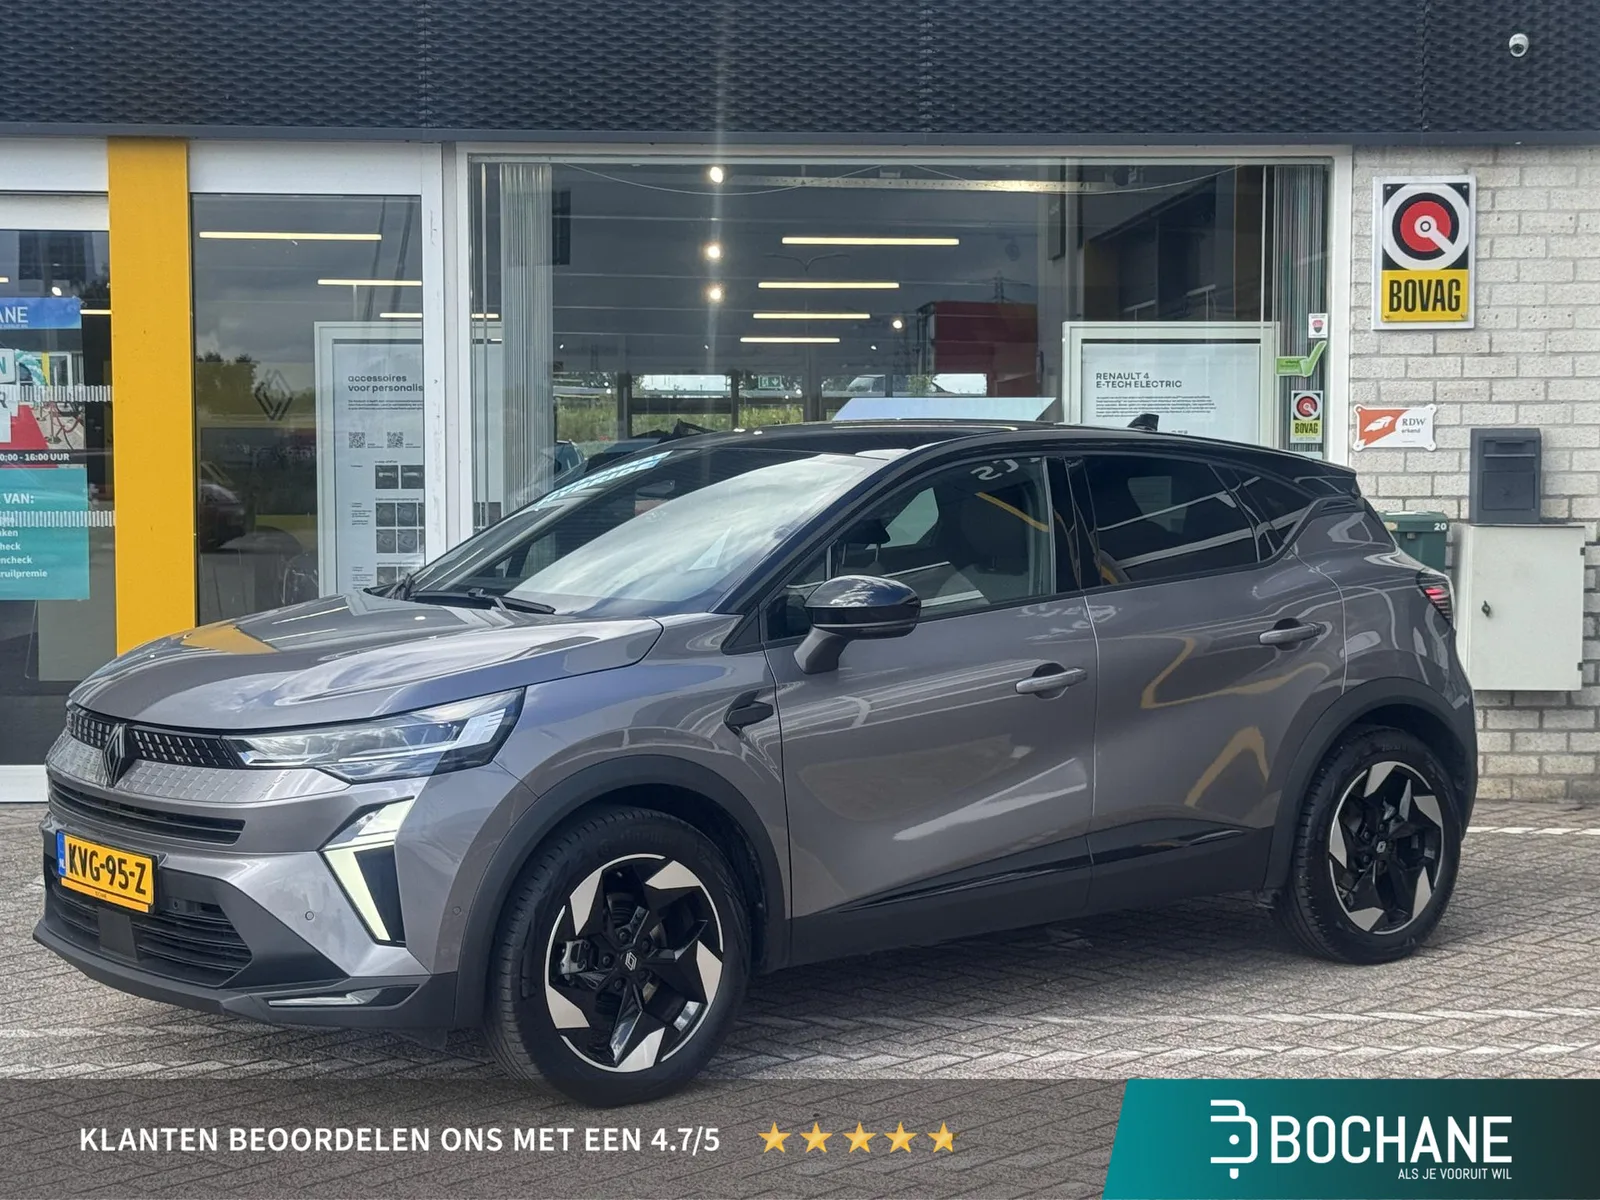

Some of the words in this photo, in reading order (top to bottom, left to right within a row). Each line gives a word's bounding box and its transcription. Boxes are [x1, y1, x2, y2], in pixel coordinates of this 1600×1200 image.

[1388, 278, 1462, 314] BOVAG
[347, 373, 407, 383] accessoires
[1095, 372, 1142, 380] RENAULT
[347, 384, 371, 392] voor
[1095, 380, 1132, 388] E-TECH
[1134, 380, 1183, 388] ELECTRIC
[1401, 418, 1426, 427] RDW
[1294, 422, 1319, 434] BOVAG
[24, 453, 49, 462] 16:00
[49, 453, 70, 461] UUR
[3, 492, 35, 504] VAN:
[1433, 522, 1448, 531] 20
[68, 842, 147, 896] KVG-95-Z
